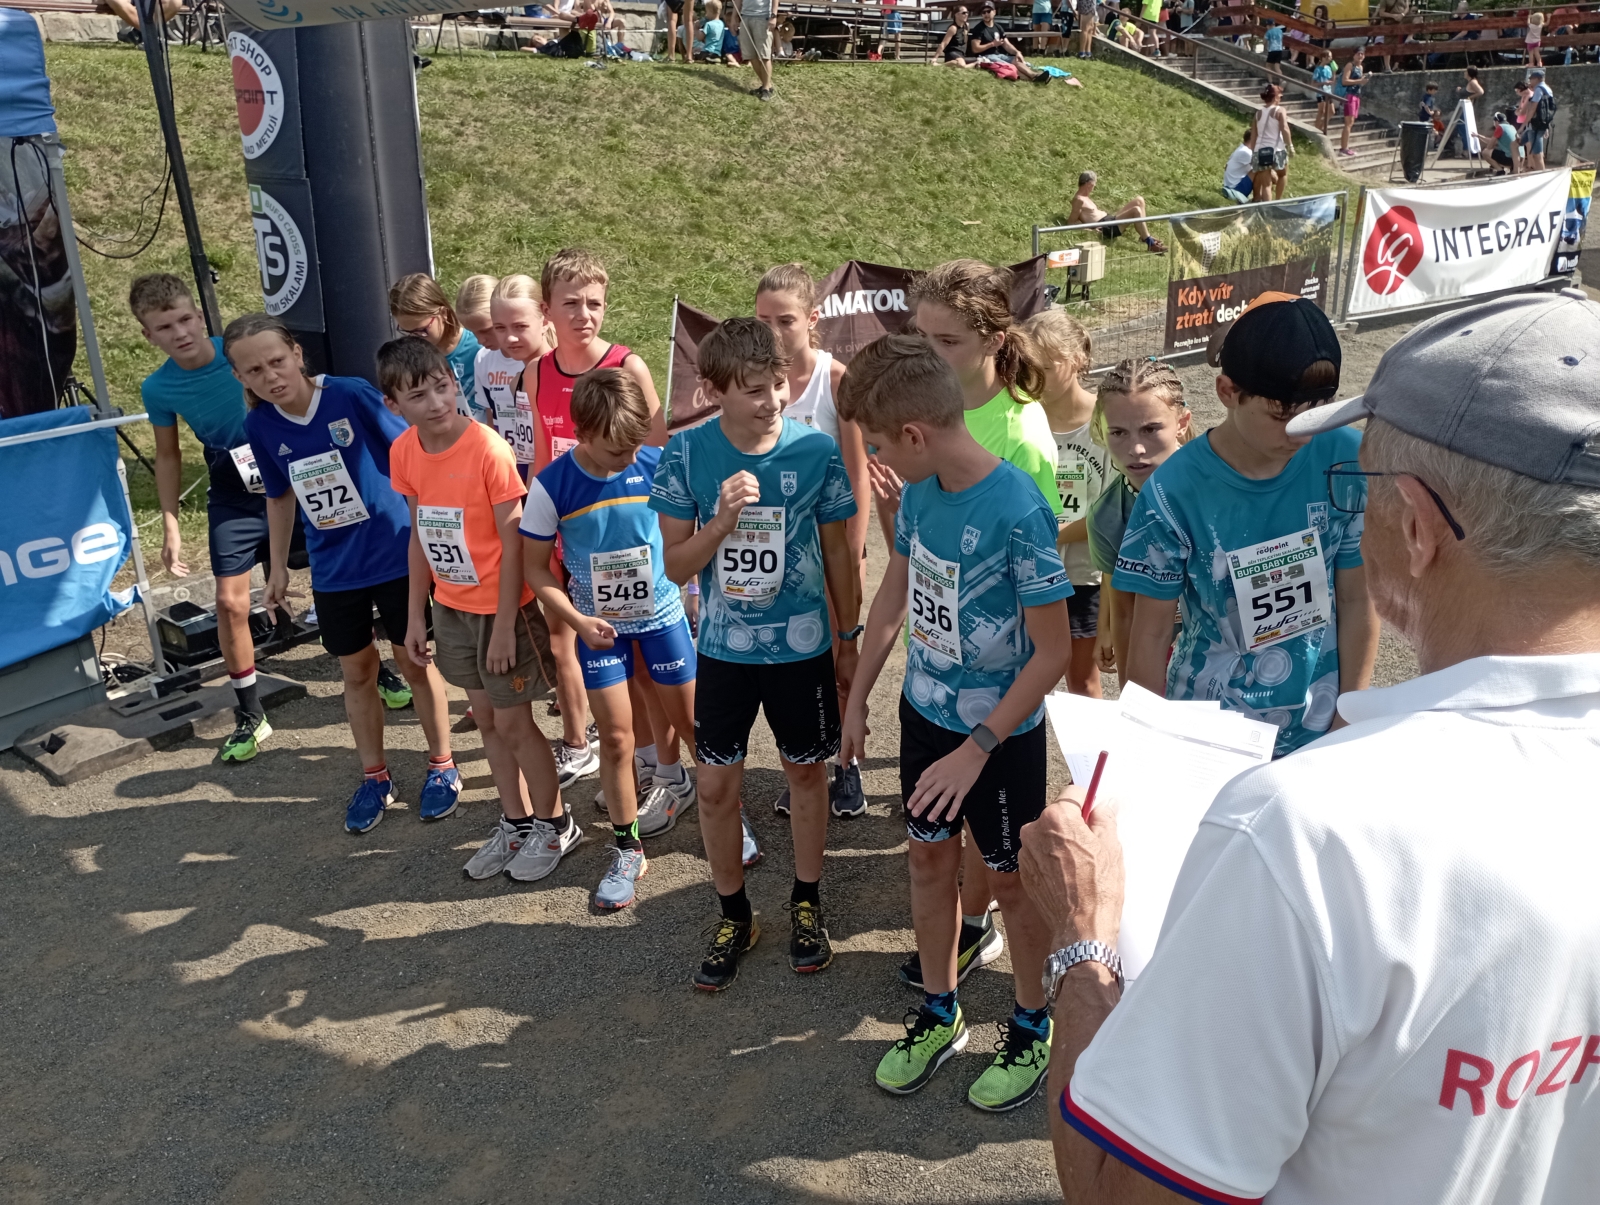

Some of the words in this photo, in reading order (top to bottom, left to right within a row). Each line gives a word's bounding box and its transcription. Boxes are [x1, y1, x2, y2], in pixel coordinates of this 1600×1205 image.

[331, 4, 371, 20] NA
[239, 38, 272, 76] SHOP
[264, 199, 285, 222] BUFO
[283, 221, 302, 256] CROSS
[1433, 210, 1562, 263] INTEGRAF
[280, 260, 305, 309] SKALAMI
[1178, 285, 1207, 309] Kdy
[1209, 281, 1234, 302] vítr
[1175, 306, 1215, 331] ztratí
[516, 422, 534, 445] 490
[322, 463, 342, 474] CROSS
[305, 485, 353, 512] 572
[444, 521, 460, 529] CROSS
[428, 543, 465, 564] 531
[1256, 541, 1289, 556] redpoint
[628, 559, 648, 567] CROSS
[723, 547, 778, 574] 590
[1115, 557, 1151, 574] OLICE
[1236, 565, 1261, 578] BUFO
[1261, 558, 1286, 571] BABY
[1286, 549, 1316, 563] CROSS
[597, 580, 649, 602] 548
[725, 575, 764, 587] bufo
[934, 574, 954, 589] CROSS
[600, 602, 637, 612] bufo
[912, 587, 953, 633] 536
[1251, 581, 1313, 622] 551
[1253, 609, 1302, 637] bufo
[587, 653, 628, 669] SkiLauf
[818, 708, 826, 729] Police
[998, 787, 1008, 804] Met.
[1001, 815, 1011, 837] Police
[1002, 837, 1012, 851] SKI
